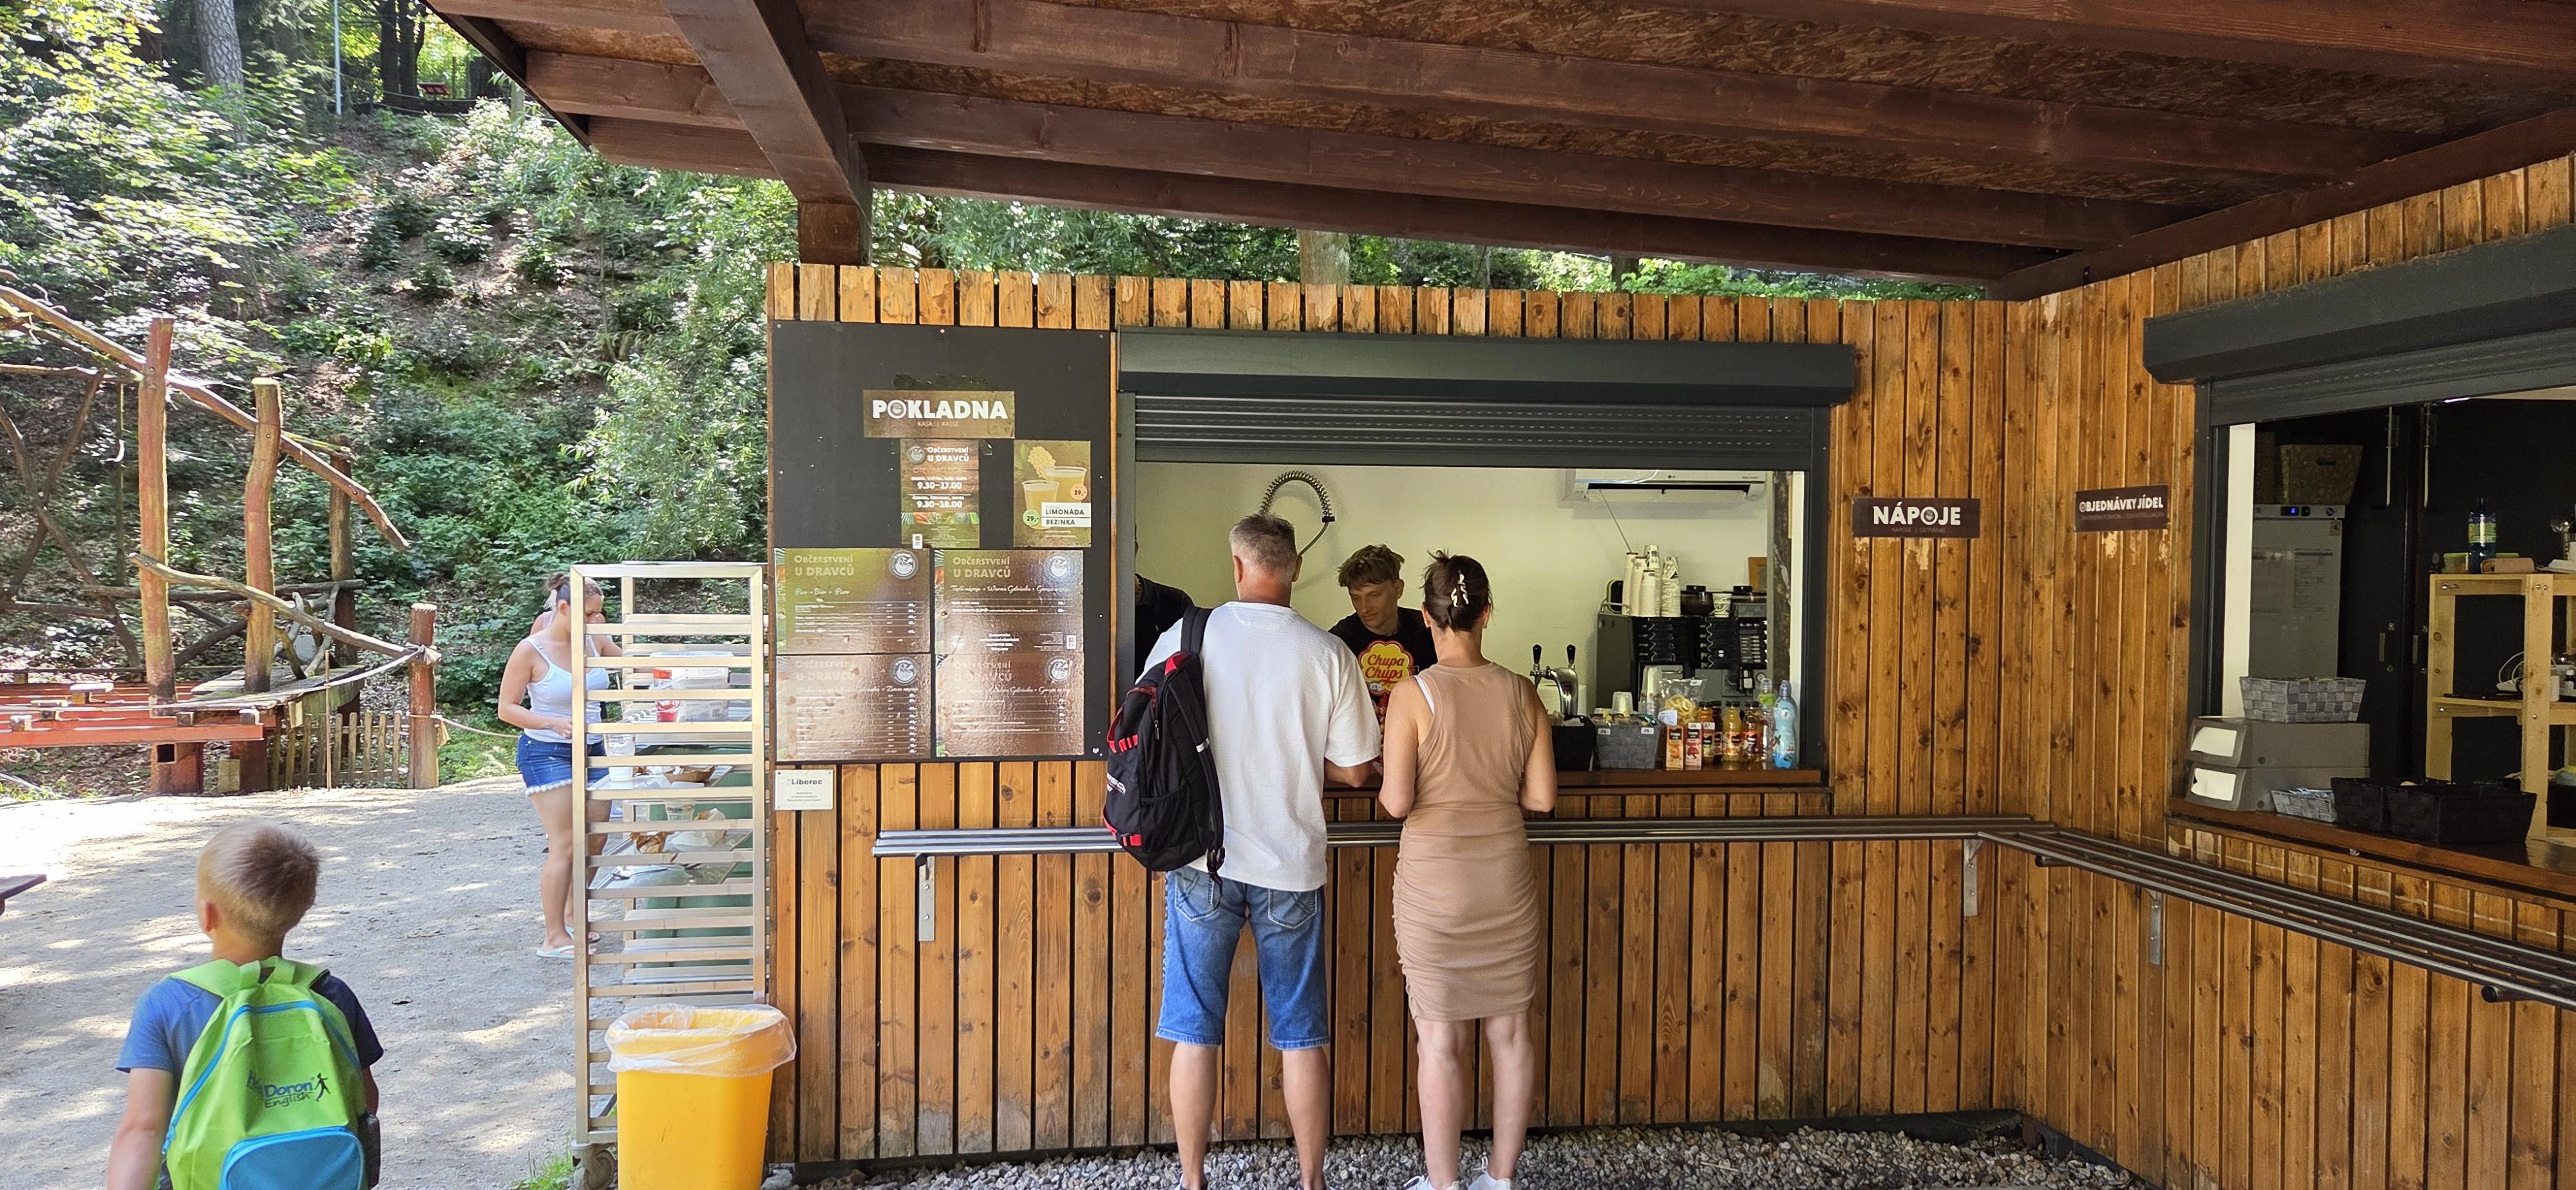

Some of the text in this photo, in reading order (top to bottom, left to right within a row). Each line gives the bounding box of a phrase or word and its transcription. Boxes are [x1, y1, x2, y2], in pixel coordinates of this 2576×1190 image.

[872, 399, 1009, 419] POKLADNA
[936, 453, 969, 462] DRAVCŮ
[2079, 494, 2164, 512] OBJEDNÁVKY JÍDEL
[1873, 502, 1961, 525] NÁPOJE
[794, 554, 853, 563] OBČERSTVENÍ
[953, 557, 1010, 565] OBČERSTVENÍ
[795, 564, 855, 576] U DRAVCŮ
[953, 566, 1011, 578] U DRAVCŮ
[1367, 654, 1405, 669] Chupa
[1365, 666, 1404, 684] Chups
[263, 1082, 314, 1098] Doron
[264, 1093, 310, 1108] English
